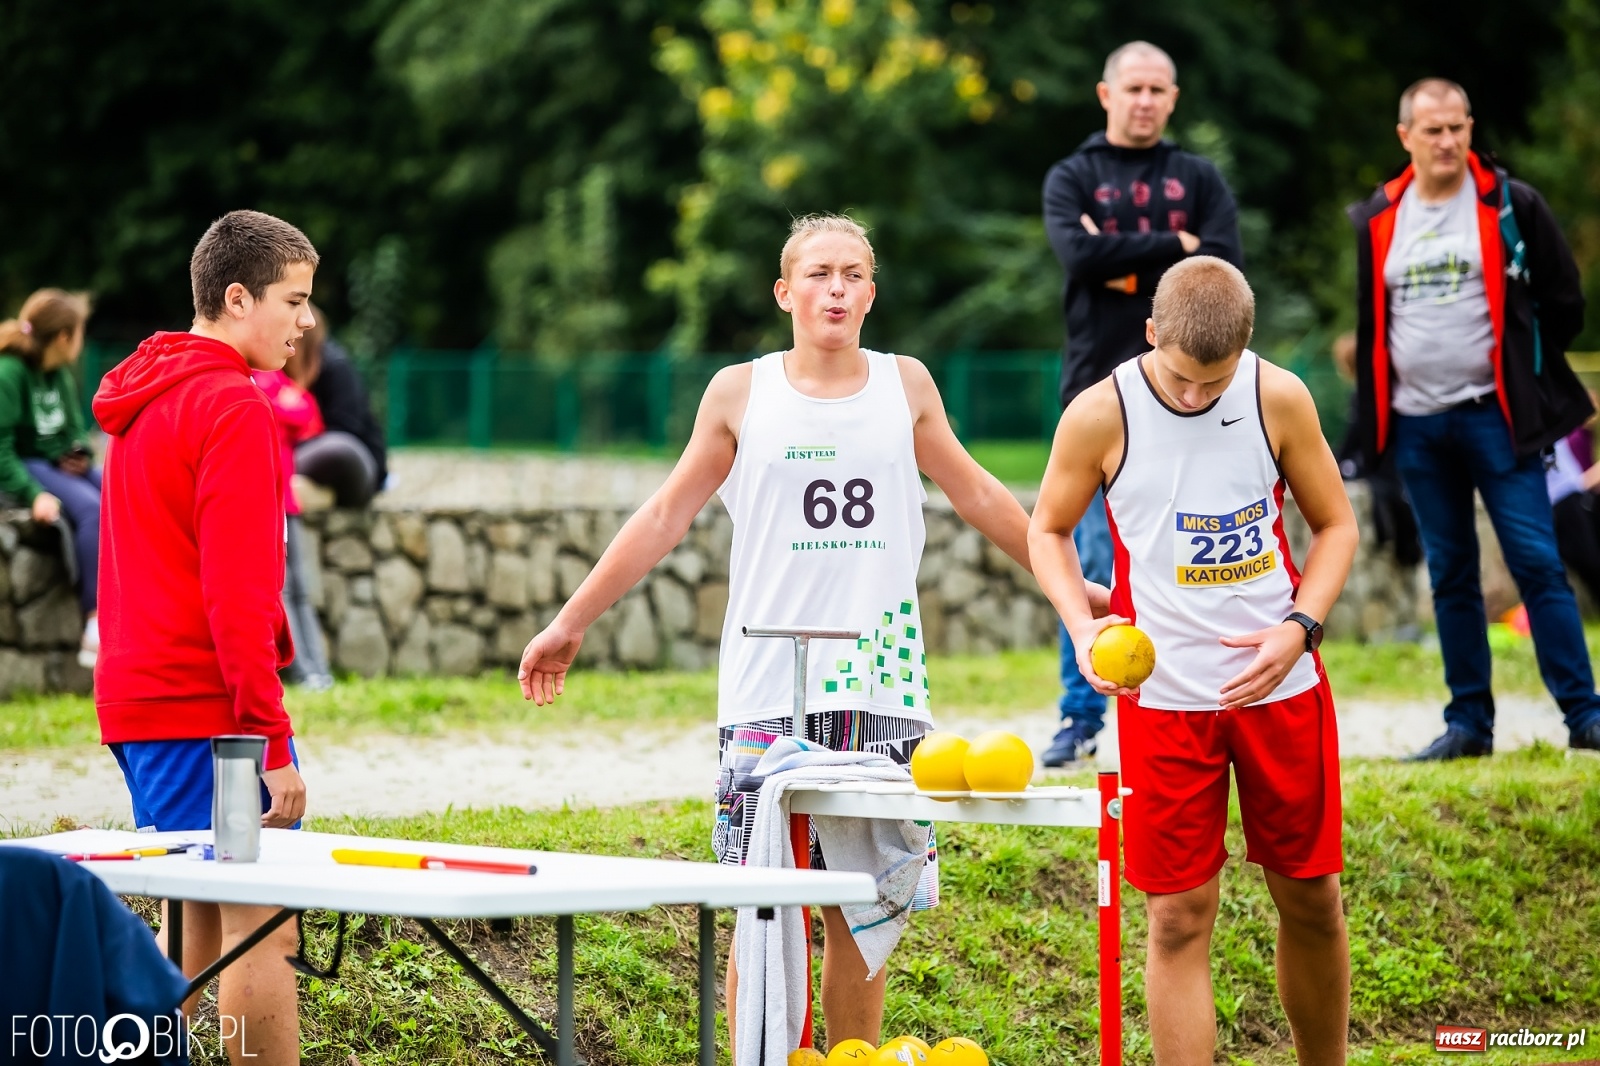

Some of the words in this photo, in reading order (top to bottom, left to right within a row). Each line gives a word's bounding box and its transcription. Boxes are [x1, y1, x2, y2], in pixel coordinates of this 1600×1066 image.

[785, 450, 813, 460] JUST
[803, 478, 875, 530] 68
[1183, 515, 1221, 532] MKS
[1234, 503, 1264, 526] MOS
[1190, 525, 1263, 565] 223
[1185, 555, 1270, 582] KATOWICE
